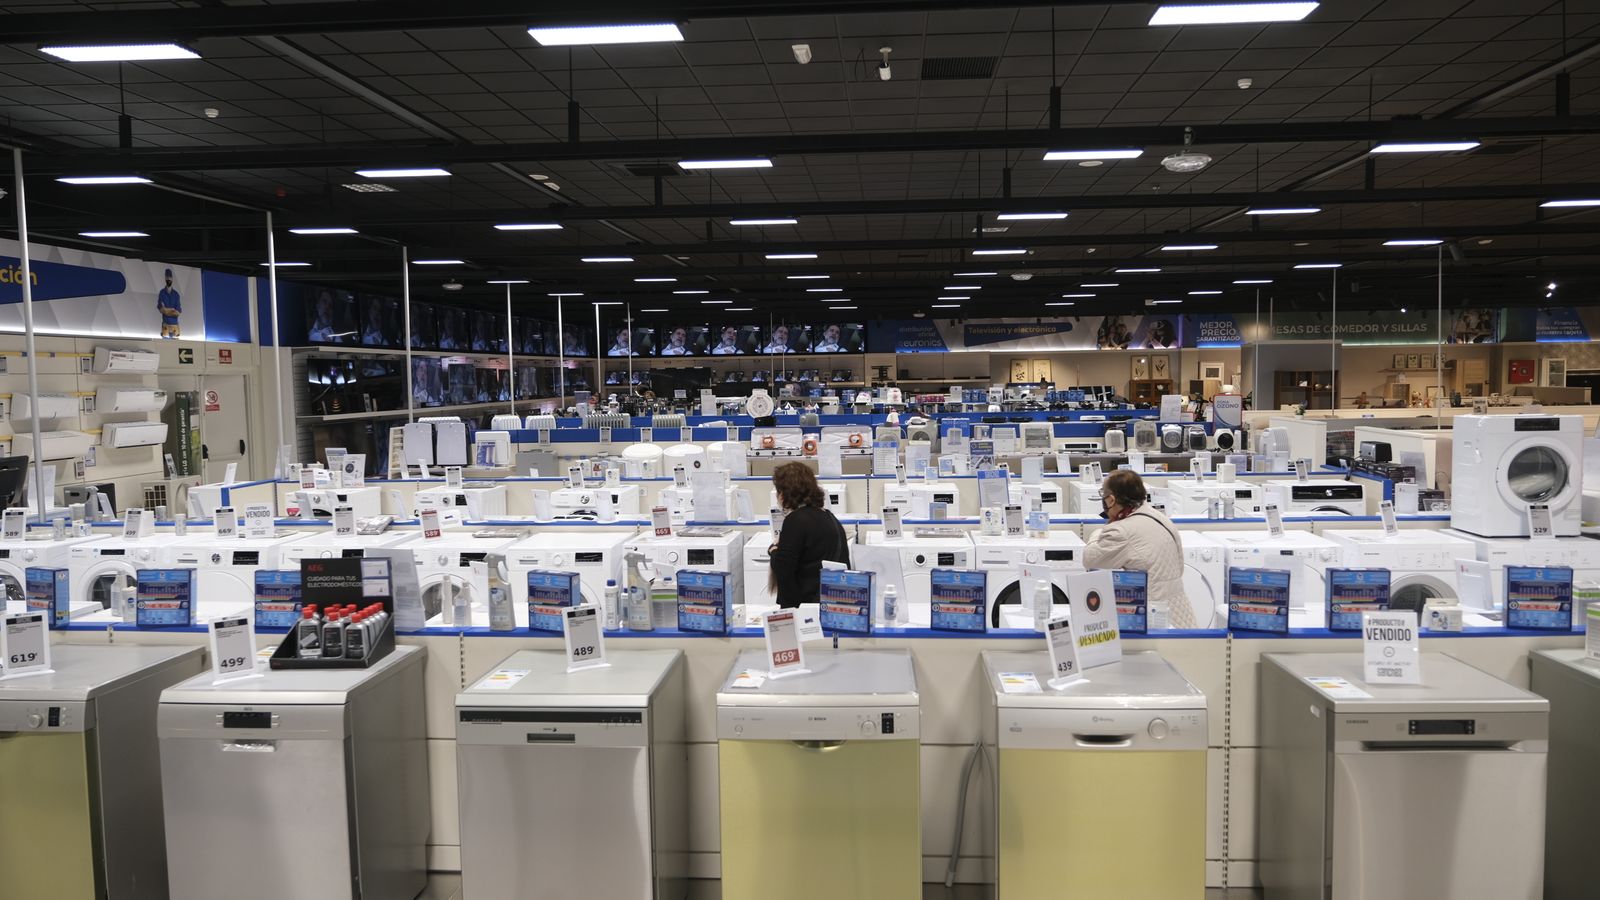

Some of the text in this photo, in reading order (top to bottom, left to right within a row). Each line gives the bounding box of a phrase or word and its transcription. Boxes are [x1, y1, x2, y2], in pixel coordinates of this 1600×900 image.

[1199, 321, 1233, 329] MEJOR
[1306, 325, 1321, 334] DE
[1323, 324, 1379, 334] COMEDOR
[1382, 324, 1390, 333] Y
[1391, 323, 1428, 332] SILLAS
[1201, 328, 1237, 336] PRECIO
[903, 339, 942, 348] euronics
[246, 510, 271, 518] VENDIDO
[1079, 630, 1116, 647] DESTACADO
[1366, 627, 1412, 641] VENDIDO
